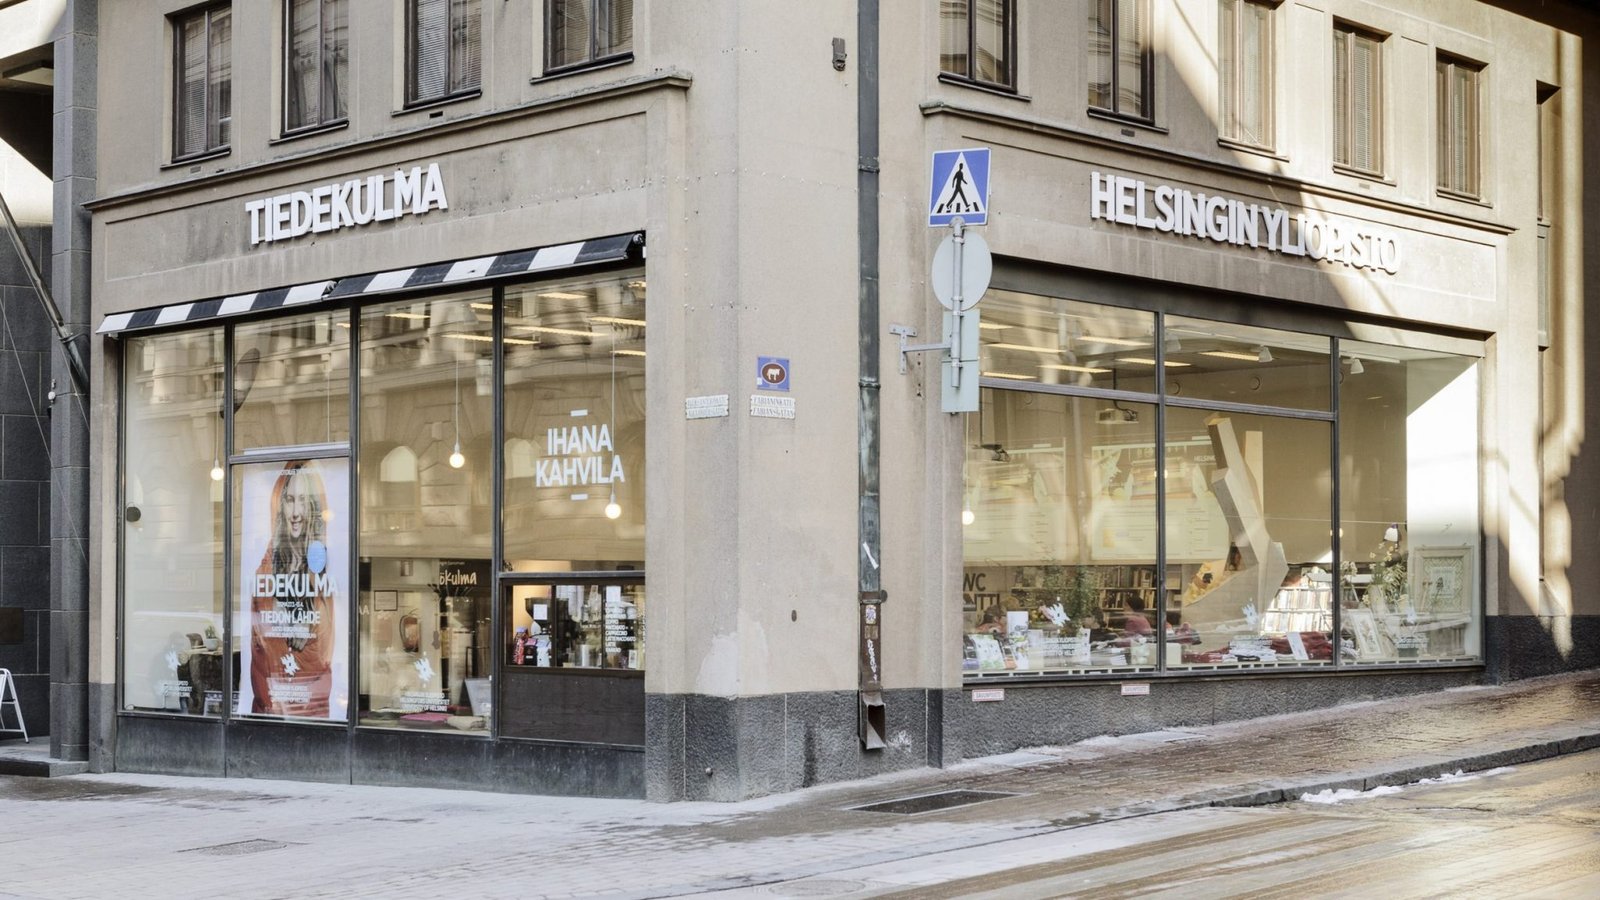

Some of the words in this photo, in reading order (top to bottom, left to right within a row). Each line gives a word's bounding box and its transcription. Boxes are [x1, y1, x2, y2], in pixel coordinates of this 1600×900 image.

[244, 162, 449, 245] TIEDEKULMA
[1091, 171, 1259, 248] HELSINGIN
[1262, 206, 1402, 275] YLIOPISTO
[547, 423, 613, 456] IHANA
[535, 454, 625, 488] KAHVILA
[246, 573, 338, 598] IEDEKULMA
[260, 610, 291, 624] TIEDON
